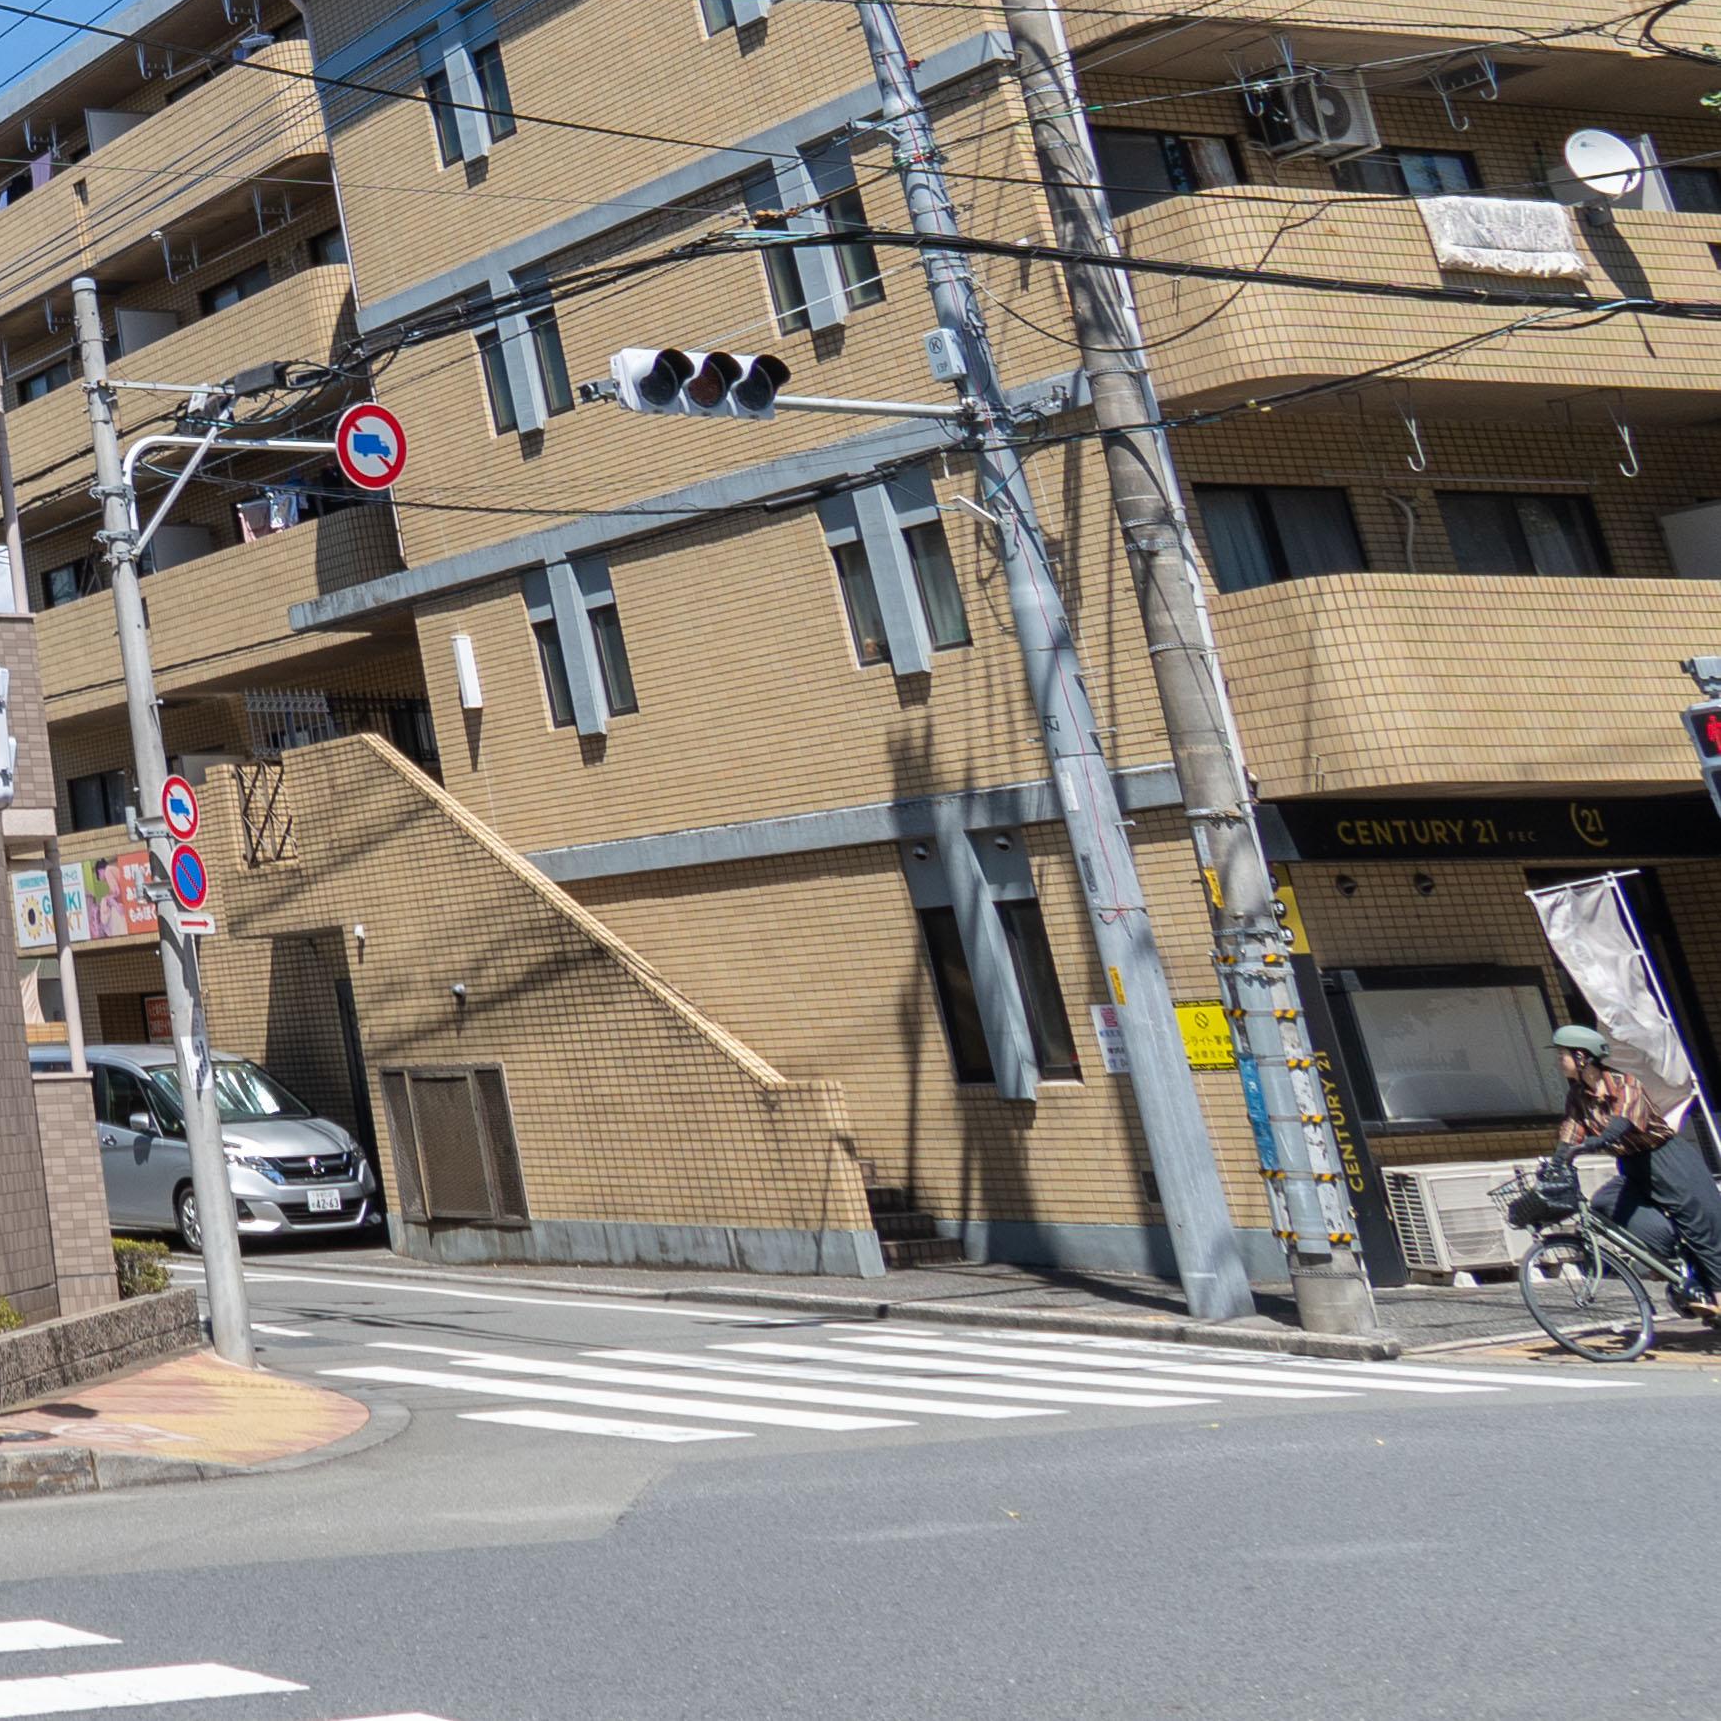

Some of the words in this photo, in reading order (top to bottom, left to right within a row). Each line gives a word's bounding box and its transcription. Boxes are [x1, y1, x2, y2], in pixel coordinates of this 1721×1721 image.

[1336, 819, 1464, 845] CENTURY
[1471, 819, 1499, 845] 21
[1313, 1050, 1332, 1072] 21
[1321, 1077, 1364, 1193] CENTURY
